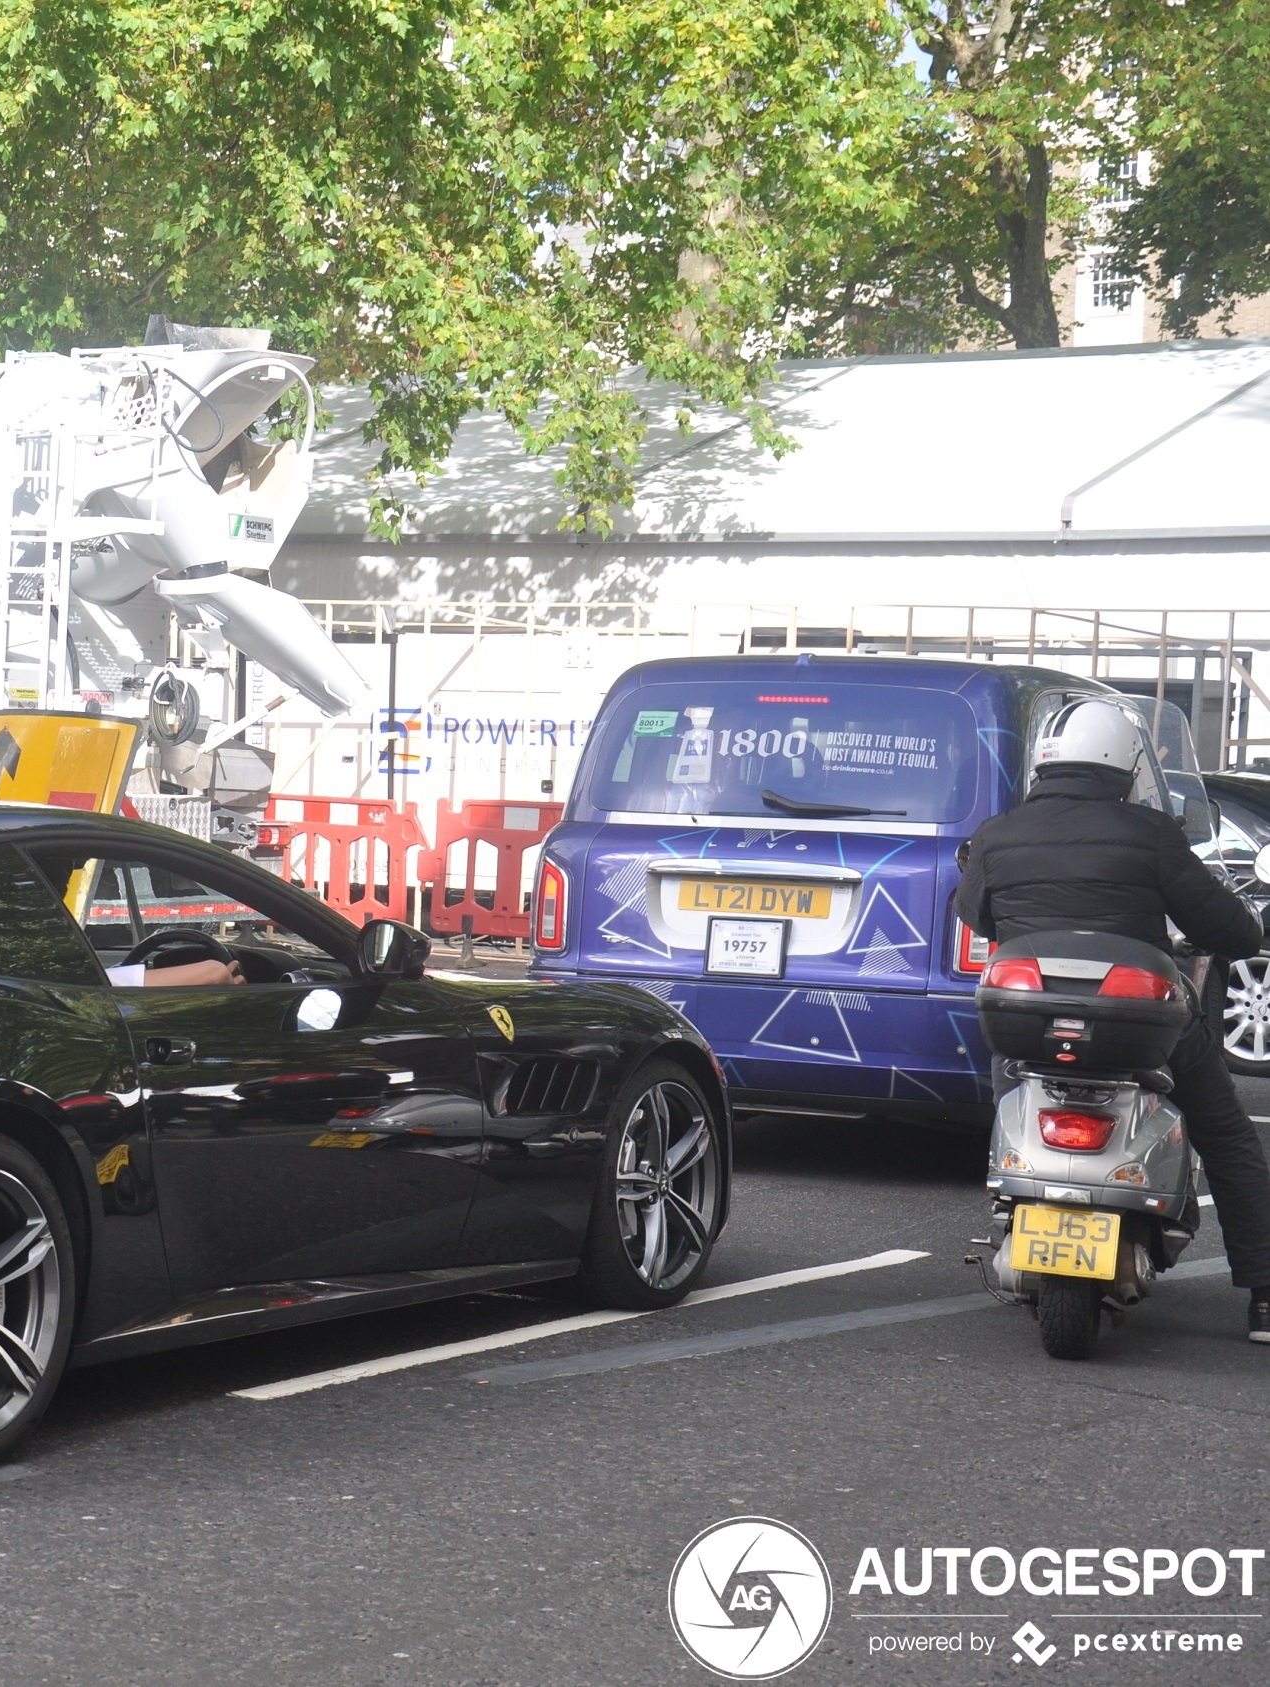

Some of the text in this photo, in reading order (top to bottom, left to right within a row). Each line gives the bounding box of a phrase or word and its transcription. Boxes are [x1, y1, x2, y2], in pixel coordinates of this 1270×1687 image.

[246, 520, 273, 532] SCHWING
[246, 530, 267, 540] Stetter
[444, 717, 558, 747] POWER
[638, 719, 665, 728] 80013
[718, 728, 808, 759] 1800
[827, 731, 937, 753] DISCOVER THE WORLD'S
[824, 747, 939, 770] MOST AWARDED TEQUILA.
[694, 883, 813, 914] LT21 DYW
[723, 939, 768, 953] 19757
[1019, 1208, 1112, 1243] LJ63
[1028, 1239, 1097, 1272] RFN
